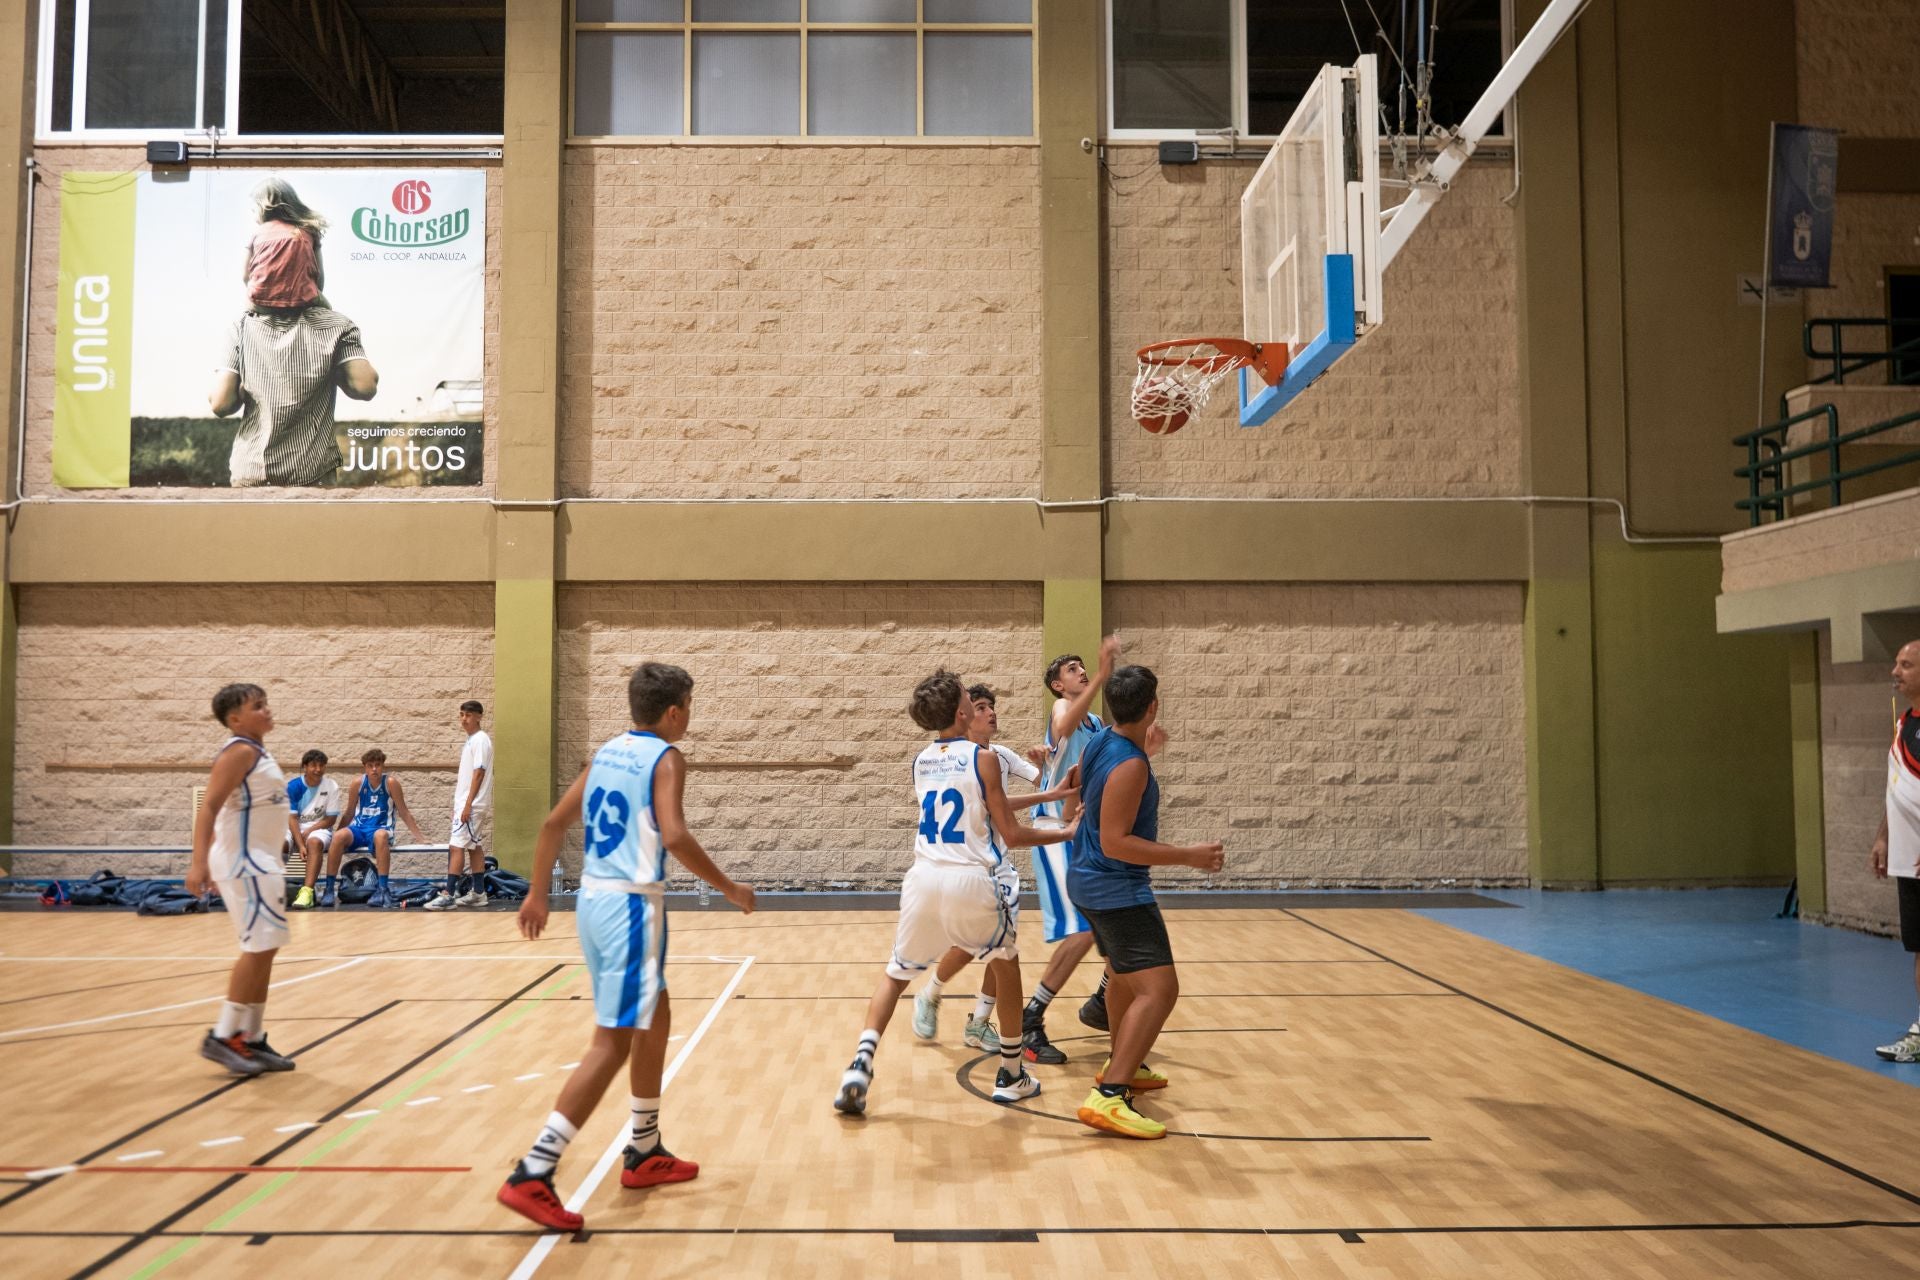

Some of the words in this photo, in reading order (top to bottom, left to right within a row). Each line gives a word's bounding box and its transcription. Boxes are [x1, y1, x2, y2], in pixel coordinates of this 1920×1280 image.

[351, 207, 470, 248] Cohorsan
[418, 253, 467, 261] ANDALUZA
[73, 275, 110, 391] unica
[347, 426, 405, 439] seguimos
[407, 426, 466, 437] creciendo
[343, 440, 466, 471] juntos
[919, 788, 965, 844] 42
